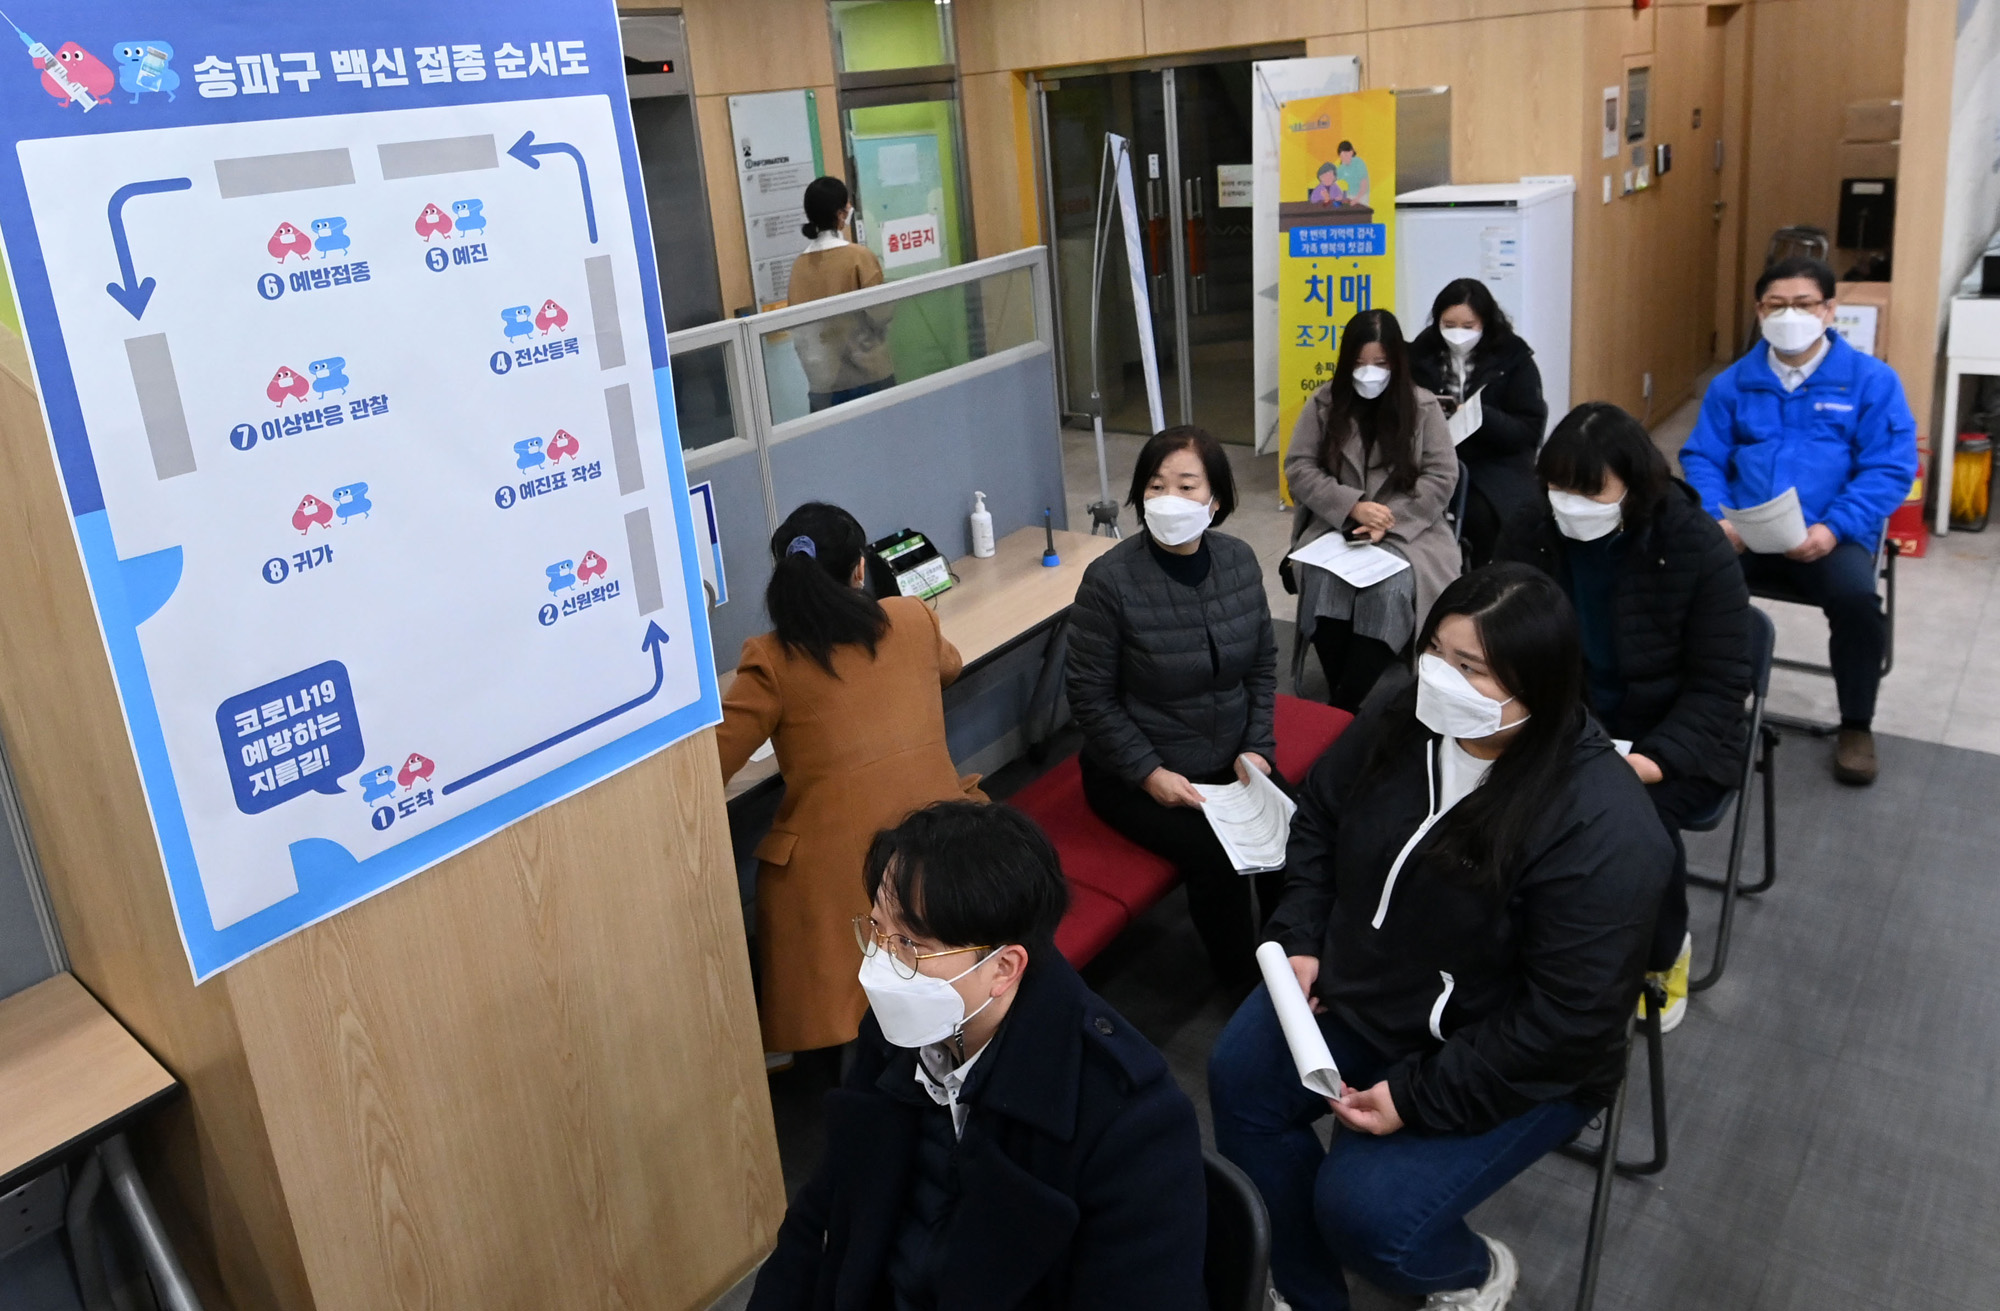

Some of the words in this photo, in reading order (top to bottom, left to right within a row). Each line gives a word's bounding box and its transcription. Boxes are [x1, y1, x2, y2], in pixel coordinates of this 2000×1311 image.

[193, 51, 321, 99] 송파구
[330, 47, 409, 89] 백신
[414, 44, 487, 84] 접종
[493, 40, 590, 80] 순서도
[753, 156, 789, 167] INFORMATION
[888, 226, 935, 253] 출입금지
[1301, 243, 1318, 255] 가족
[1320, 242, 1346, 255] 행복의
[1347, 241, 1373, 254] 첫걸음
[1329, 228, 1355, 240] 기억력
[452, 242, 489, 266] 예진
[288, 260, 371, 293] 예방접종
[1304, 274, 1372, 317] 치매
[514, 337, 580, 368] 전산등록
[1295, 325, 1347, 350] 조기
[261, 404, 344, 441] 이상반응
[348, 394, 390, 421] 관찰
[519, 471, 568, 500] 예진표
[571, 460, 602, 483] 작성
[292, 543, 334, 573] 귀가
[561, 579, 621, 617] 신원확인
[234, 679, 337, 738] 코로나19
[241, 711, 342, 767] 예방하는
[249, 744, 331, 797] 지름길!
[397, 788, 435, 819] 도착
